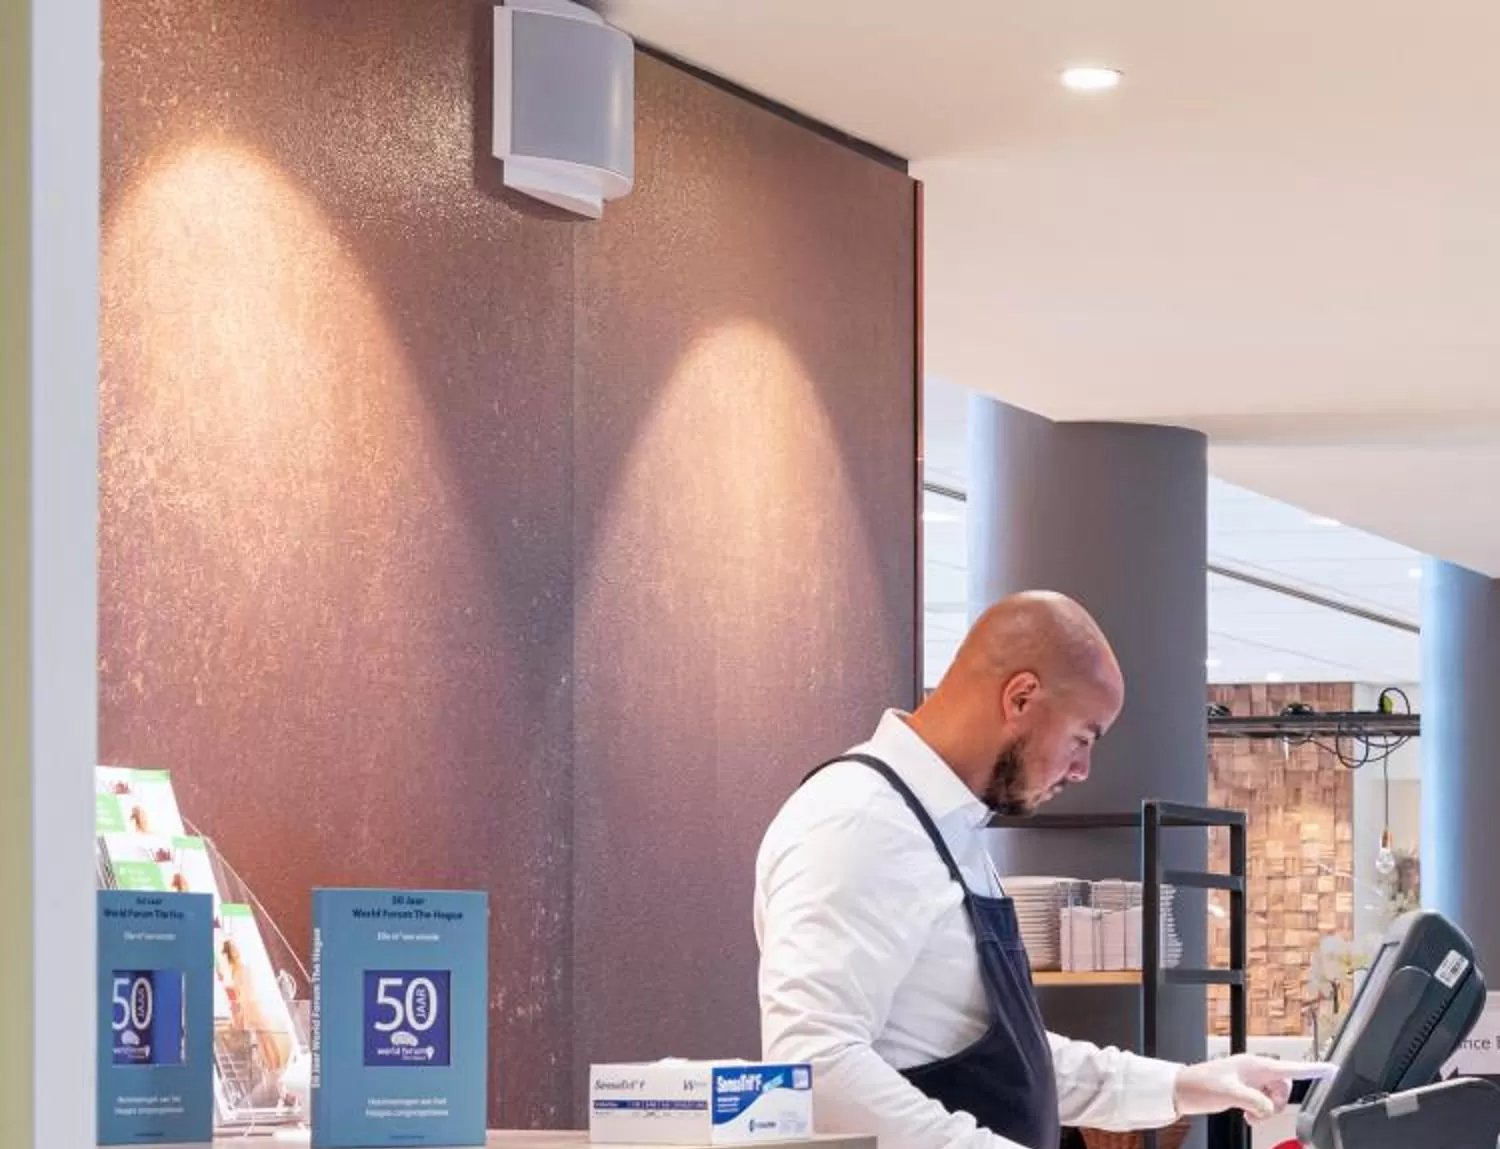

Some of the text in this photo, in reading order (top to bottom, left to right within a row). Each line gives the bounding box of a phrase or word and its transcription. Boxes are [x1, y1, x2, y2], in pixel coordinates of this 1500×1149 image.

[352, 908, 381, 918] World
[414, 909, 431, 919] The
[433, 910, 463, 922] Hague
[312, 928, 323, 961] Hague
[312, 963, 323, 982] The
[112, 977, 152, 1030] 50
[312, 985, 322, 1016] Forum
[374, 977, 438, 1031] 50
[415, 987, 426, 1019] JAAR
[311, 1019, 322, 1050] World
[1460, 1038, 1491, 1050] nce
